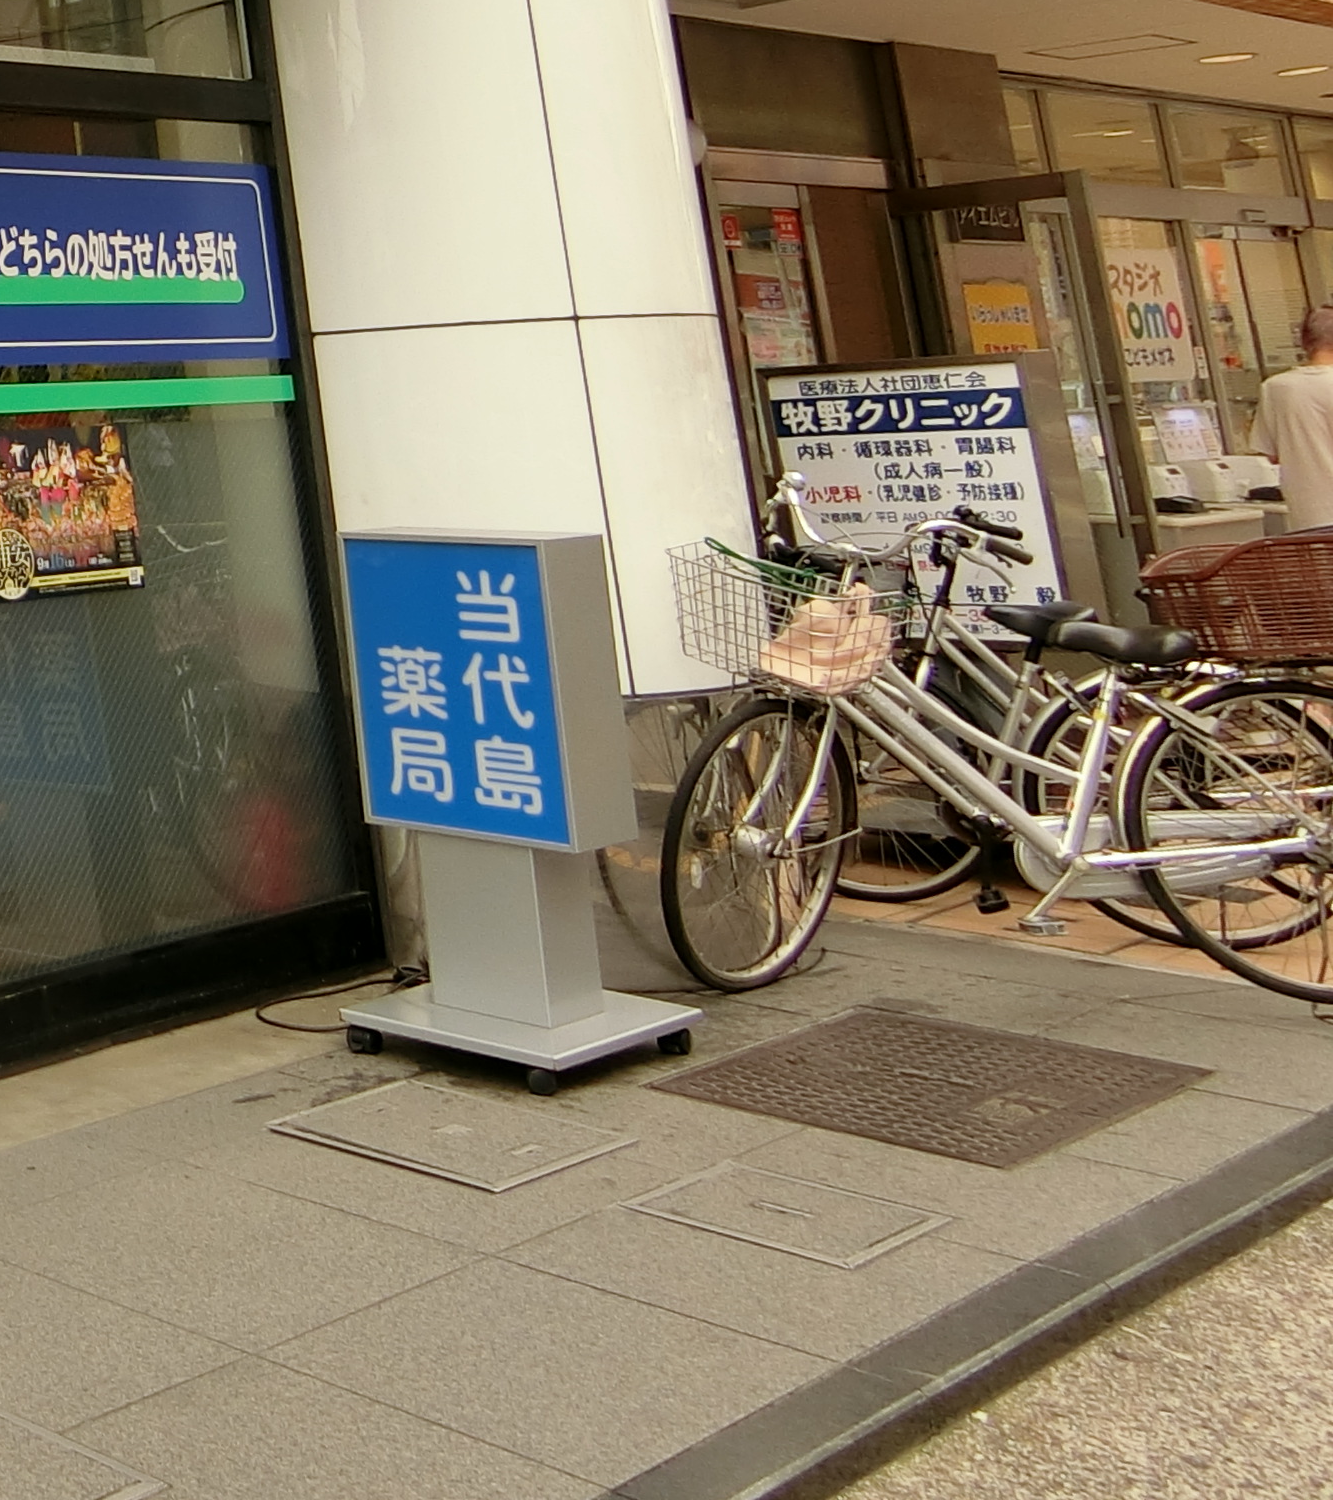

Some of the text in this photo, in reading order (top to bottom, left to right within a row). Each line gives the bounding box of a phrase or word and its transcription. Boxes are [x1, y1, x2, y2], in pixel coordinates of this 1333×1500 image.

[798, 371, 987, 397] 医療法人社団恵仁会
[781, 392, 1013, 435] 牧野クリニック
[966, 584, 1009, 604] 牧野
[455, 569, 544, 816] 当代島
[376, 644, 454, 803] 薬局
